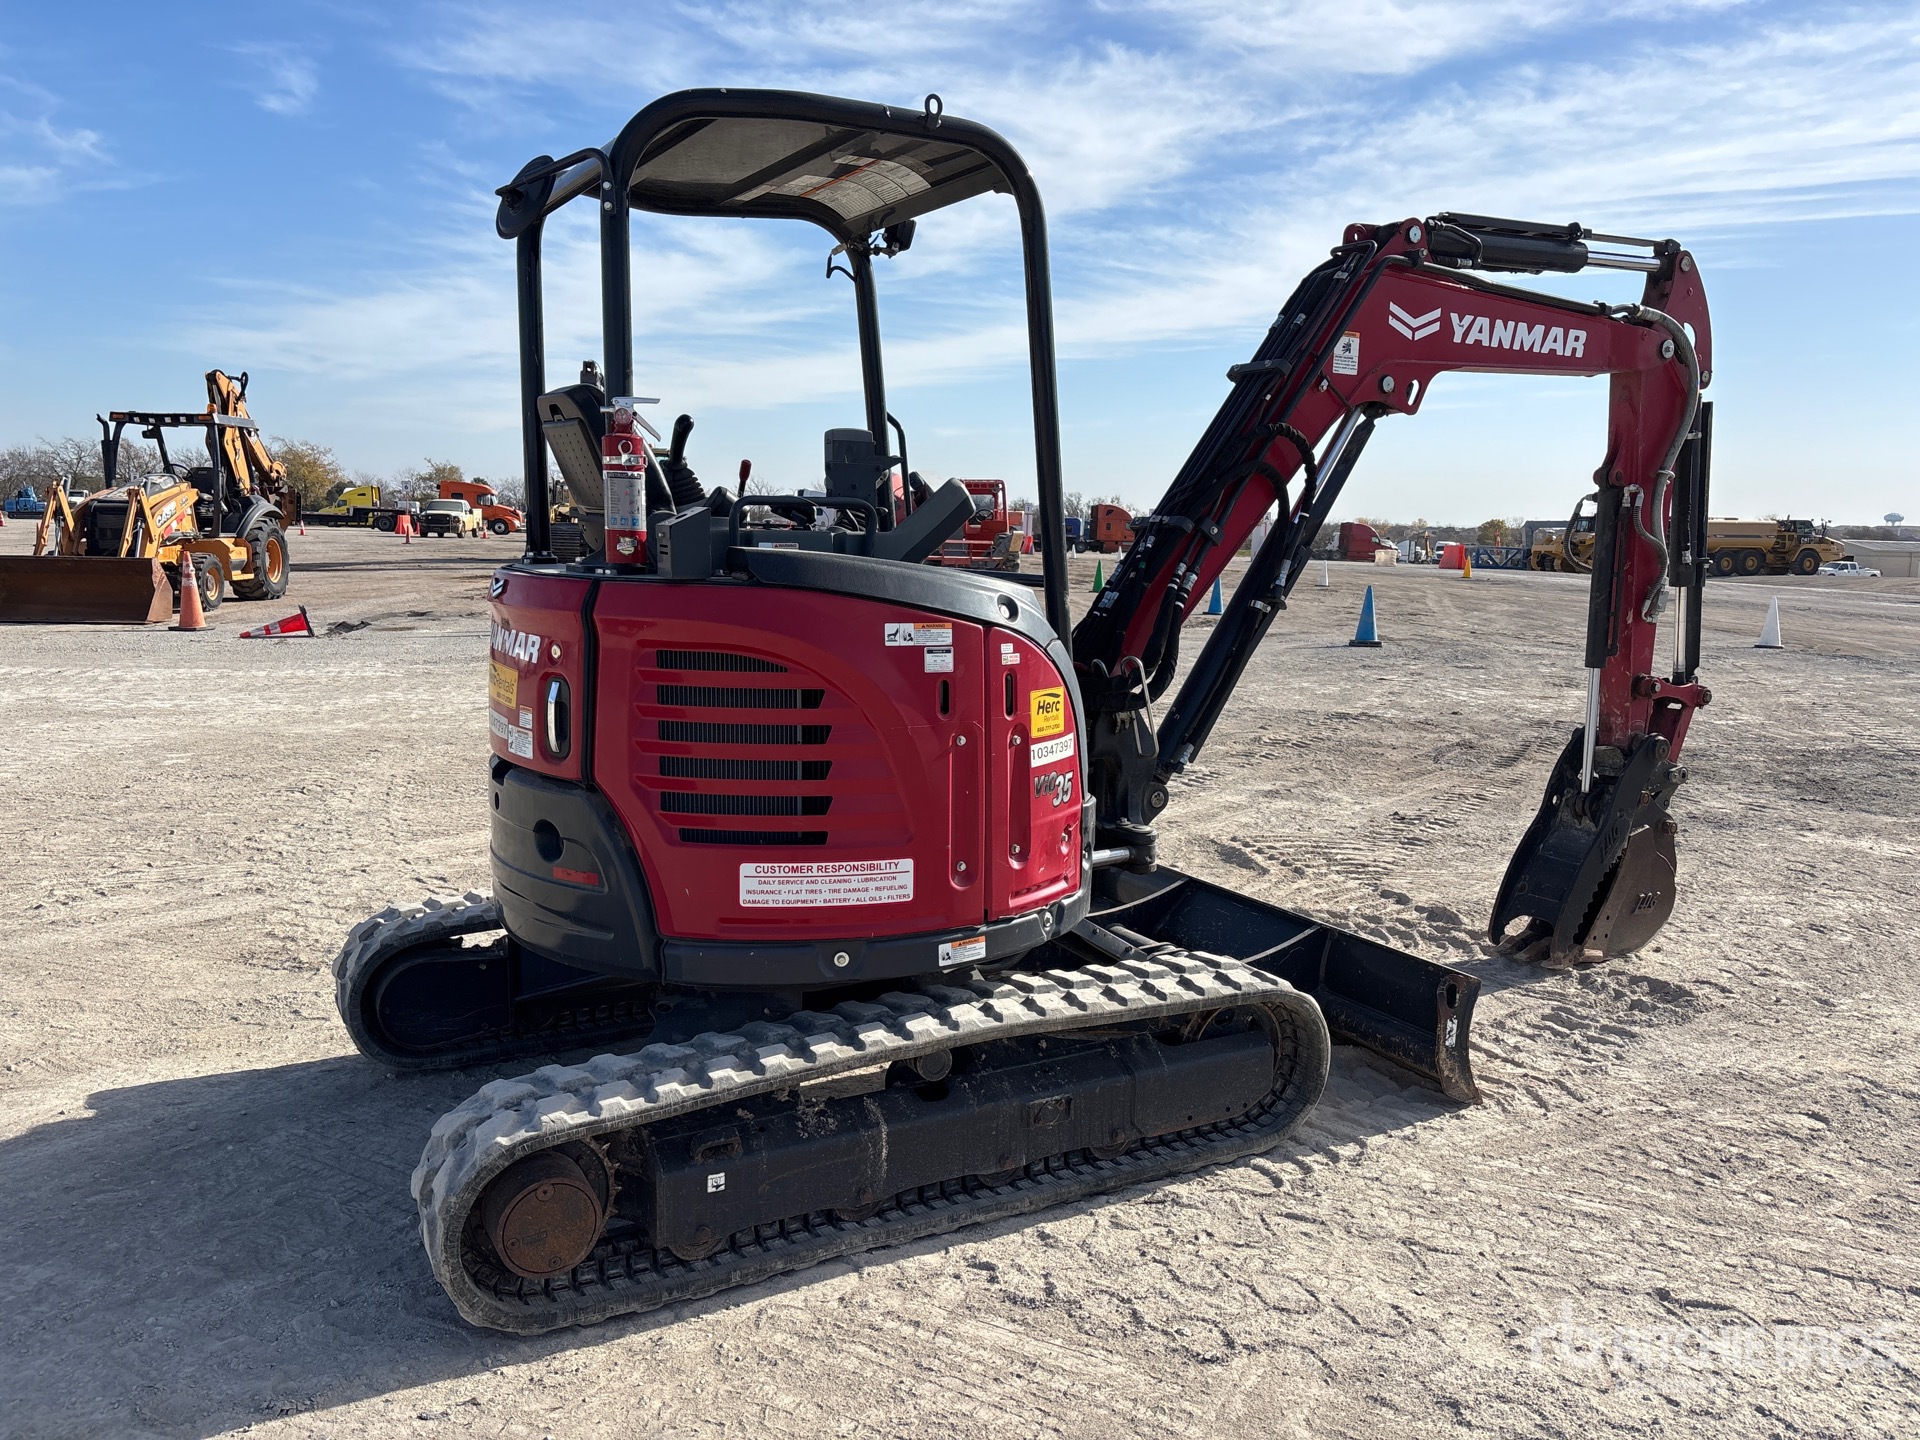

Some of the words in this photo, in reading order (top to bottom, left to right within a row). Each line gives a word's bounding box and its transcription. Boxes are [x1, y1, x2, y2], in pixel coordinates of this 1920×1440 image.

[1450, 312, 1587, 358] YANMAR
[156, 500, 176, 528] CASE
[1037, 699, 1060, 715] Herc
[1031, 738, 1073, 760] 10347397
[754, 864, 814, 875] CUSTOMER
[816, 861, 900, 874] RESPONSIBILITY
[820, 877, 852, 885] CLEANING
[857, 875, 897, 884] LUBRICATION
[843, 886, 870, 894] DAMAGE
[875, 884, 908, 892] REFUELING
[887, 893, 911, 901] FILTERS
